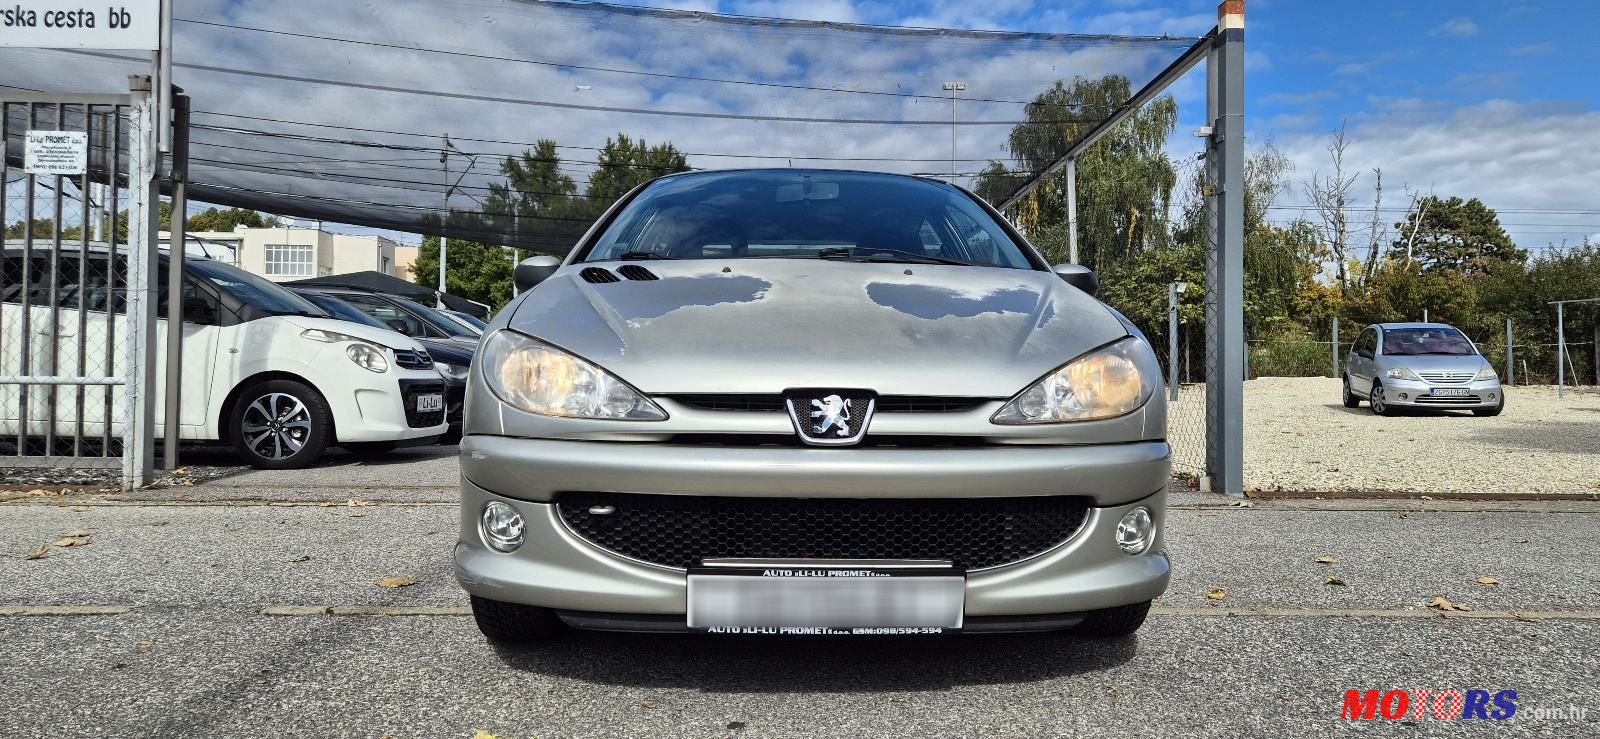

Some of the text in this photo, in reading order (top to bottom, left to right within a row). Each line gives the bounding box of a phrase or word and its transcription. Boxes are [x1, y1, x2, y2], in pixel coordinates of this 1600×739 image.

[44, 8, 95, 28] cesta
[109, 7, 131, 29] bb
[45, 135, 70, 143] PROMET
